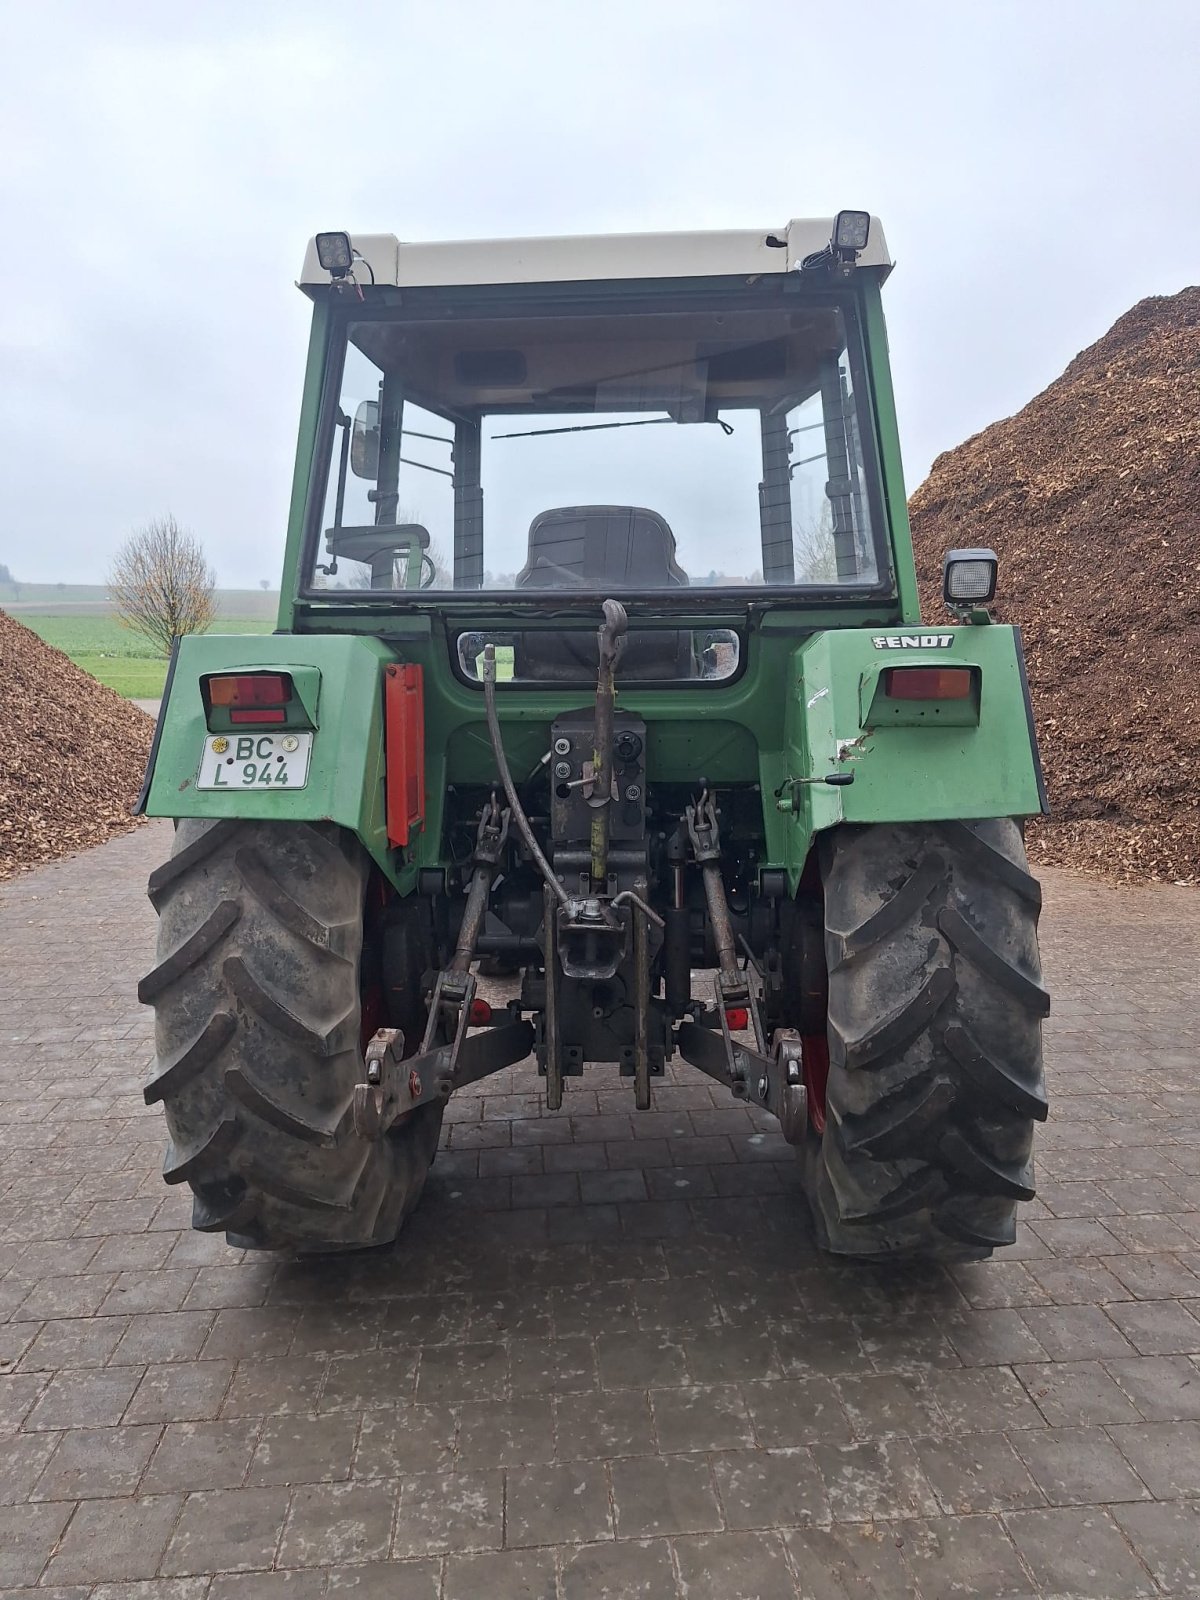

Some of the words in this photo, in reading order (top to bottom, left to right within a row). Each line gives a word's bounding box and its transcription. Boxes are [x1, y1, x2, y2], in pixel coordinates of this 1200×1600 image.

[873, 635, 954, 648] FENDT
[236, 737, 274, 761] BC
[214, 763, 228, 786] L
[242, 763, 289, 785] 944
